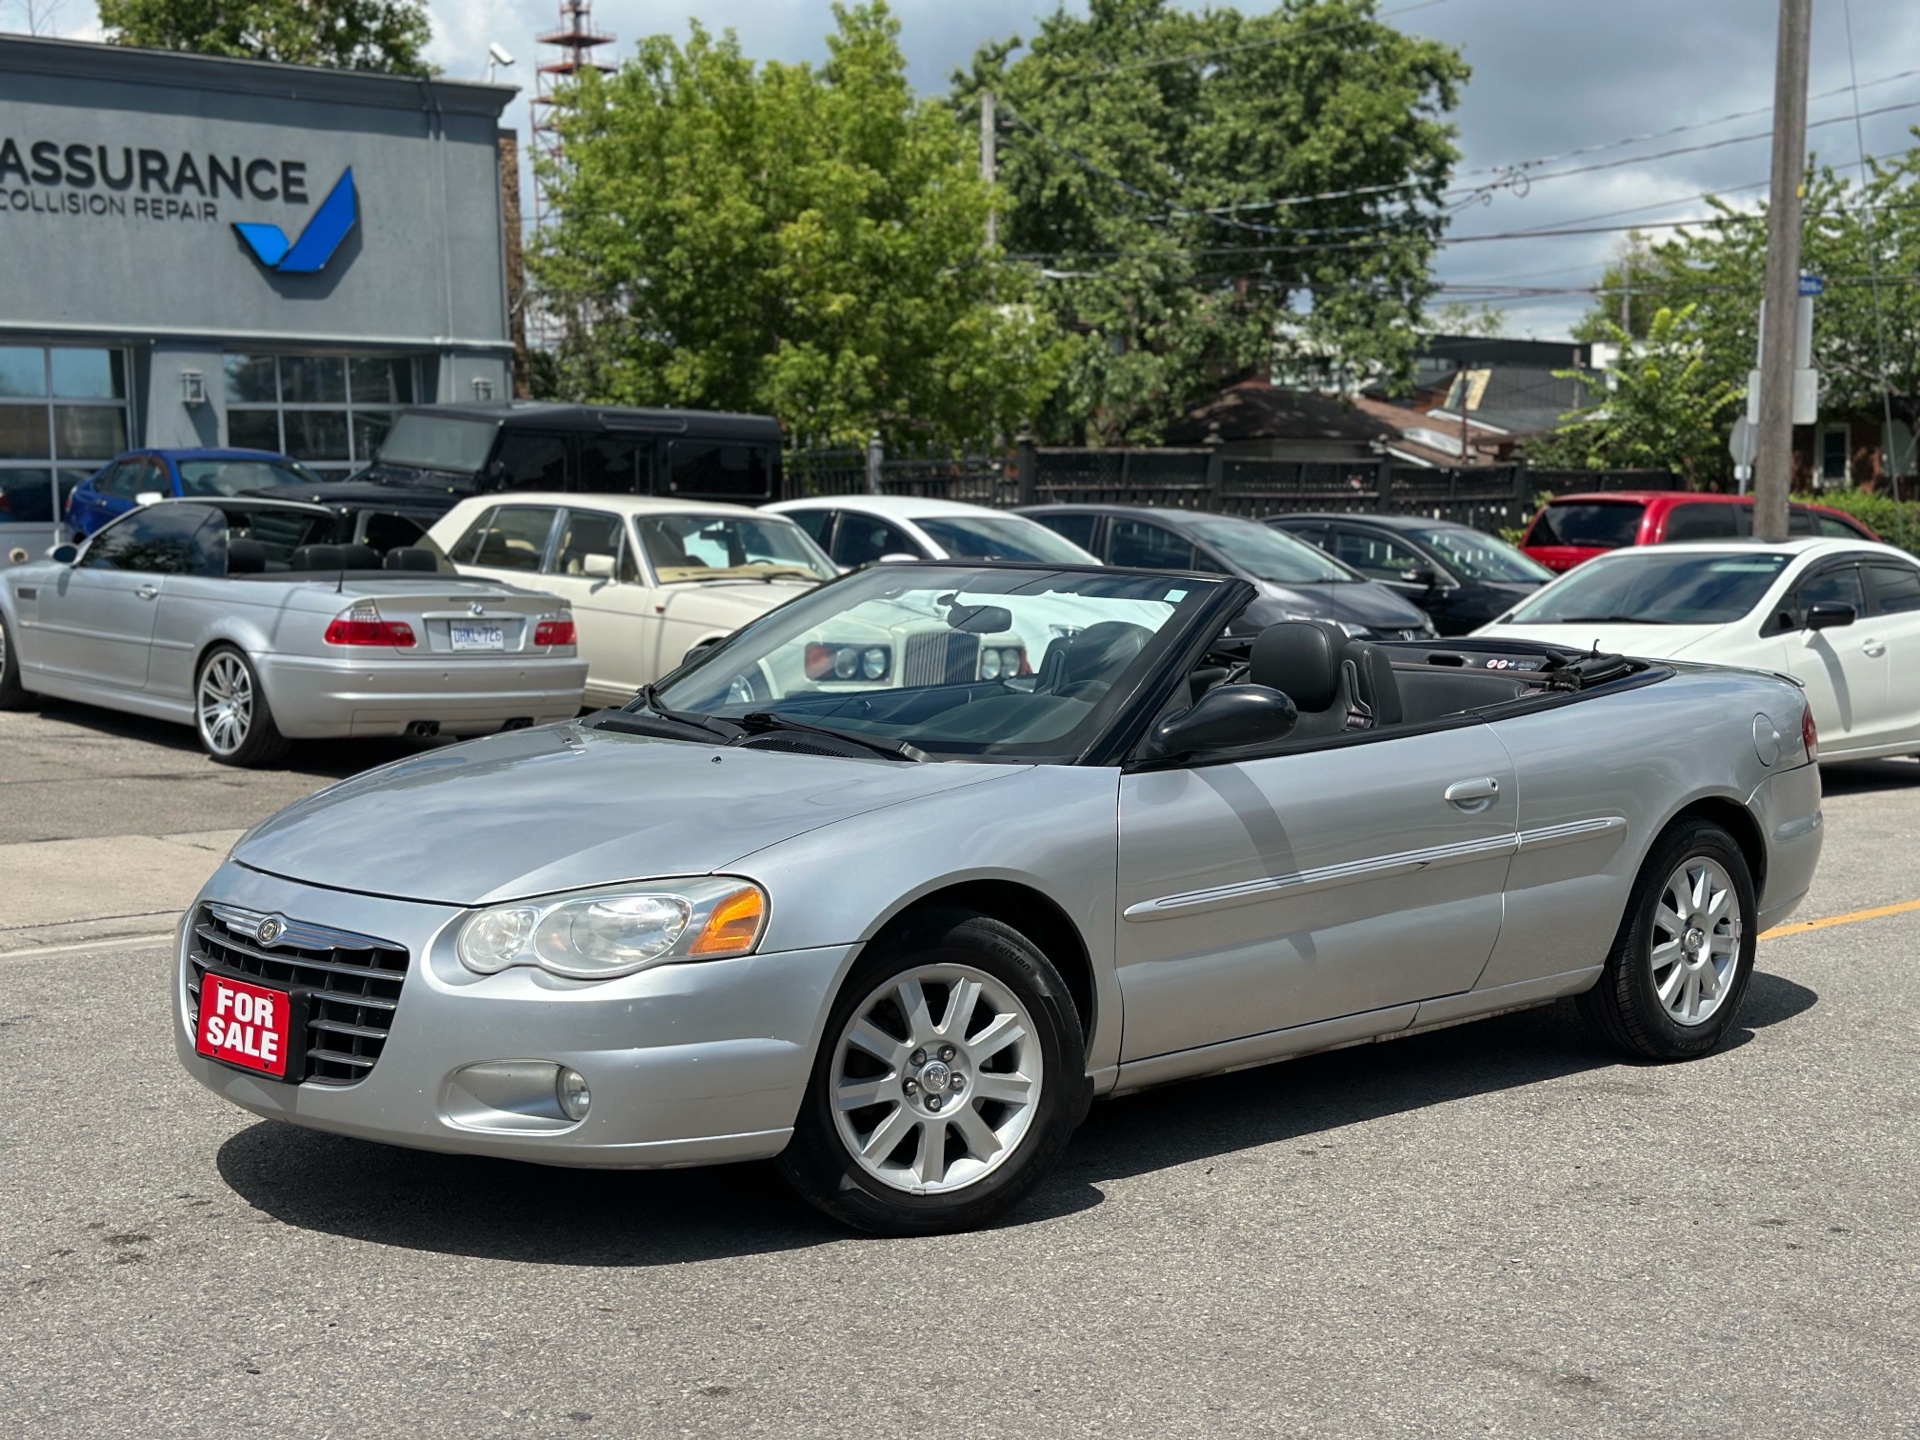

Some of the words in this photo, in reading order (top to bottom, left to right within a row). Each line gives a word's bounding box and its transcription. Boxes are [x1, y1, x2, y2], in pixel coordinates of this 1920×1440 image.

[0, 138, 308, 204] ASSURANCE
[135, 197, 218, 222] REPAIR
[990, 942, 1031, 971] Edition
[216, 986, 275, 1028] FOR
[207, 1017, 279, 1062] SALE
